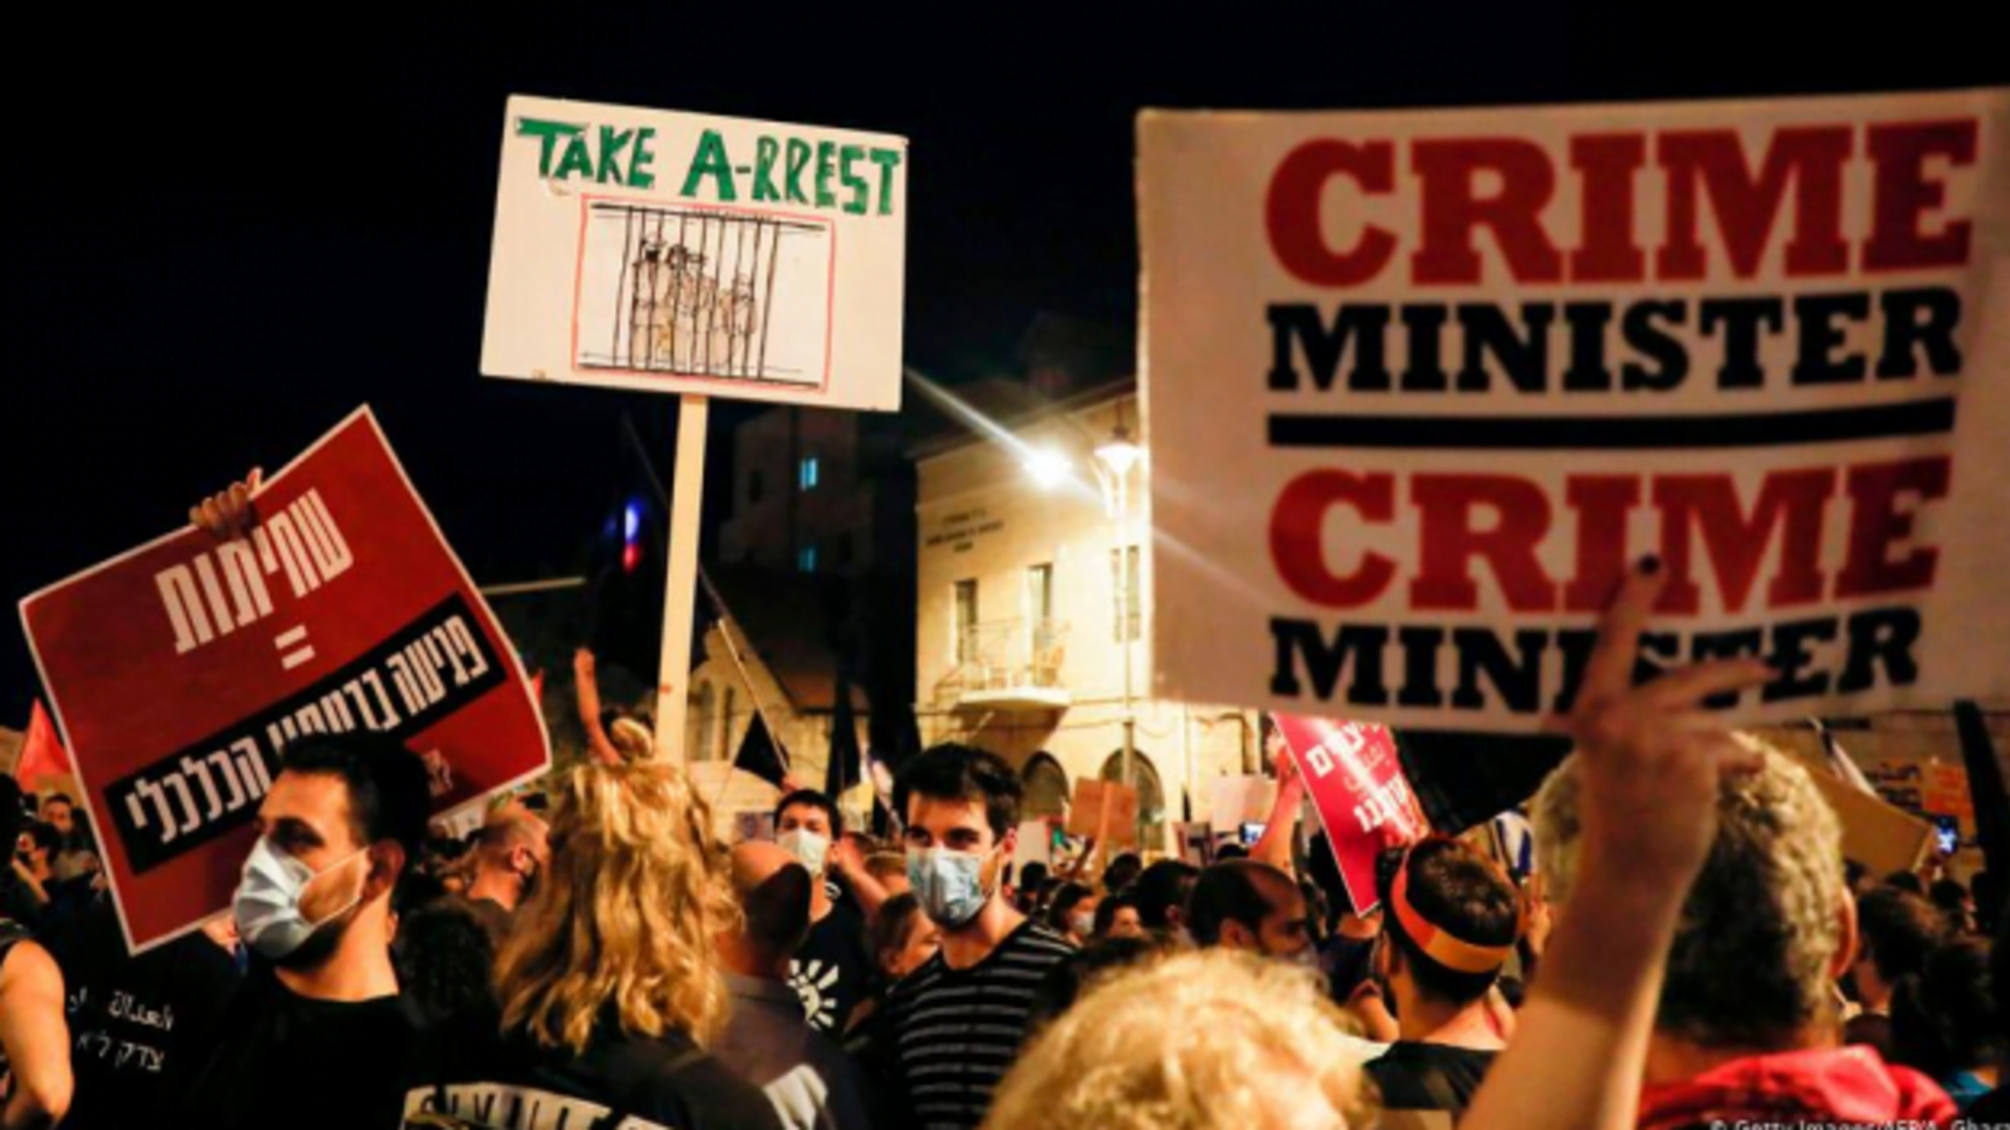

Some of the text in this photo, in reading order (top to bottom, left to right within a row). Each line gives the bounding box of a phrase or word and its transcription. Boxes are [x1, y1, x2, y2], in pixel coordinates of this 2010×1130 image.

[515, 116, 902, 216] TAKE A-RREST
[1264, 117, 1980, 289] CRIME
[1266, 286, 1963, 393] MINISTER
[153, 486, 354, 656] שחיתות
[1267, 454, 1953, 616] CRIME
[385, 614, 490, 717] פגיעה
[124, 735, 273, 844] הכלכלי
